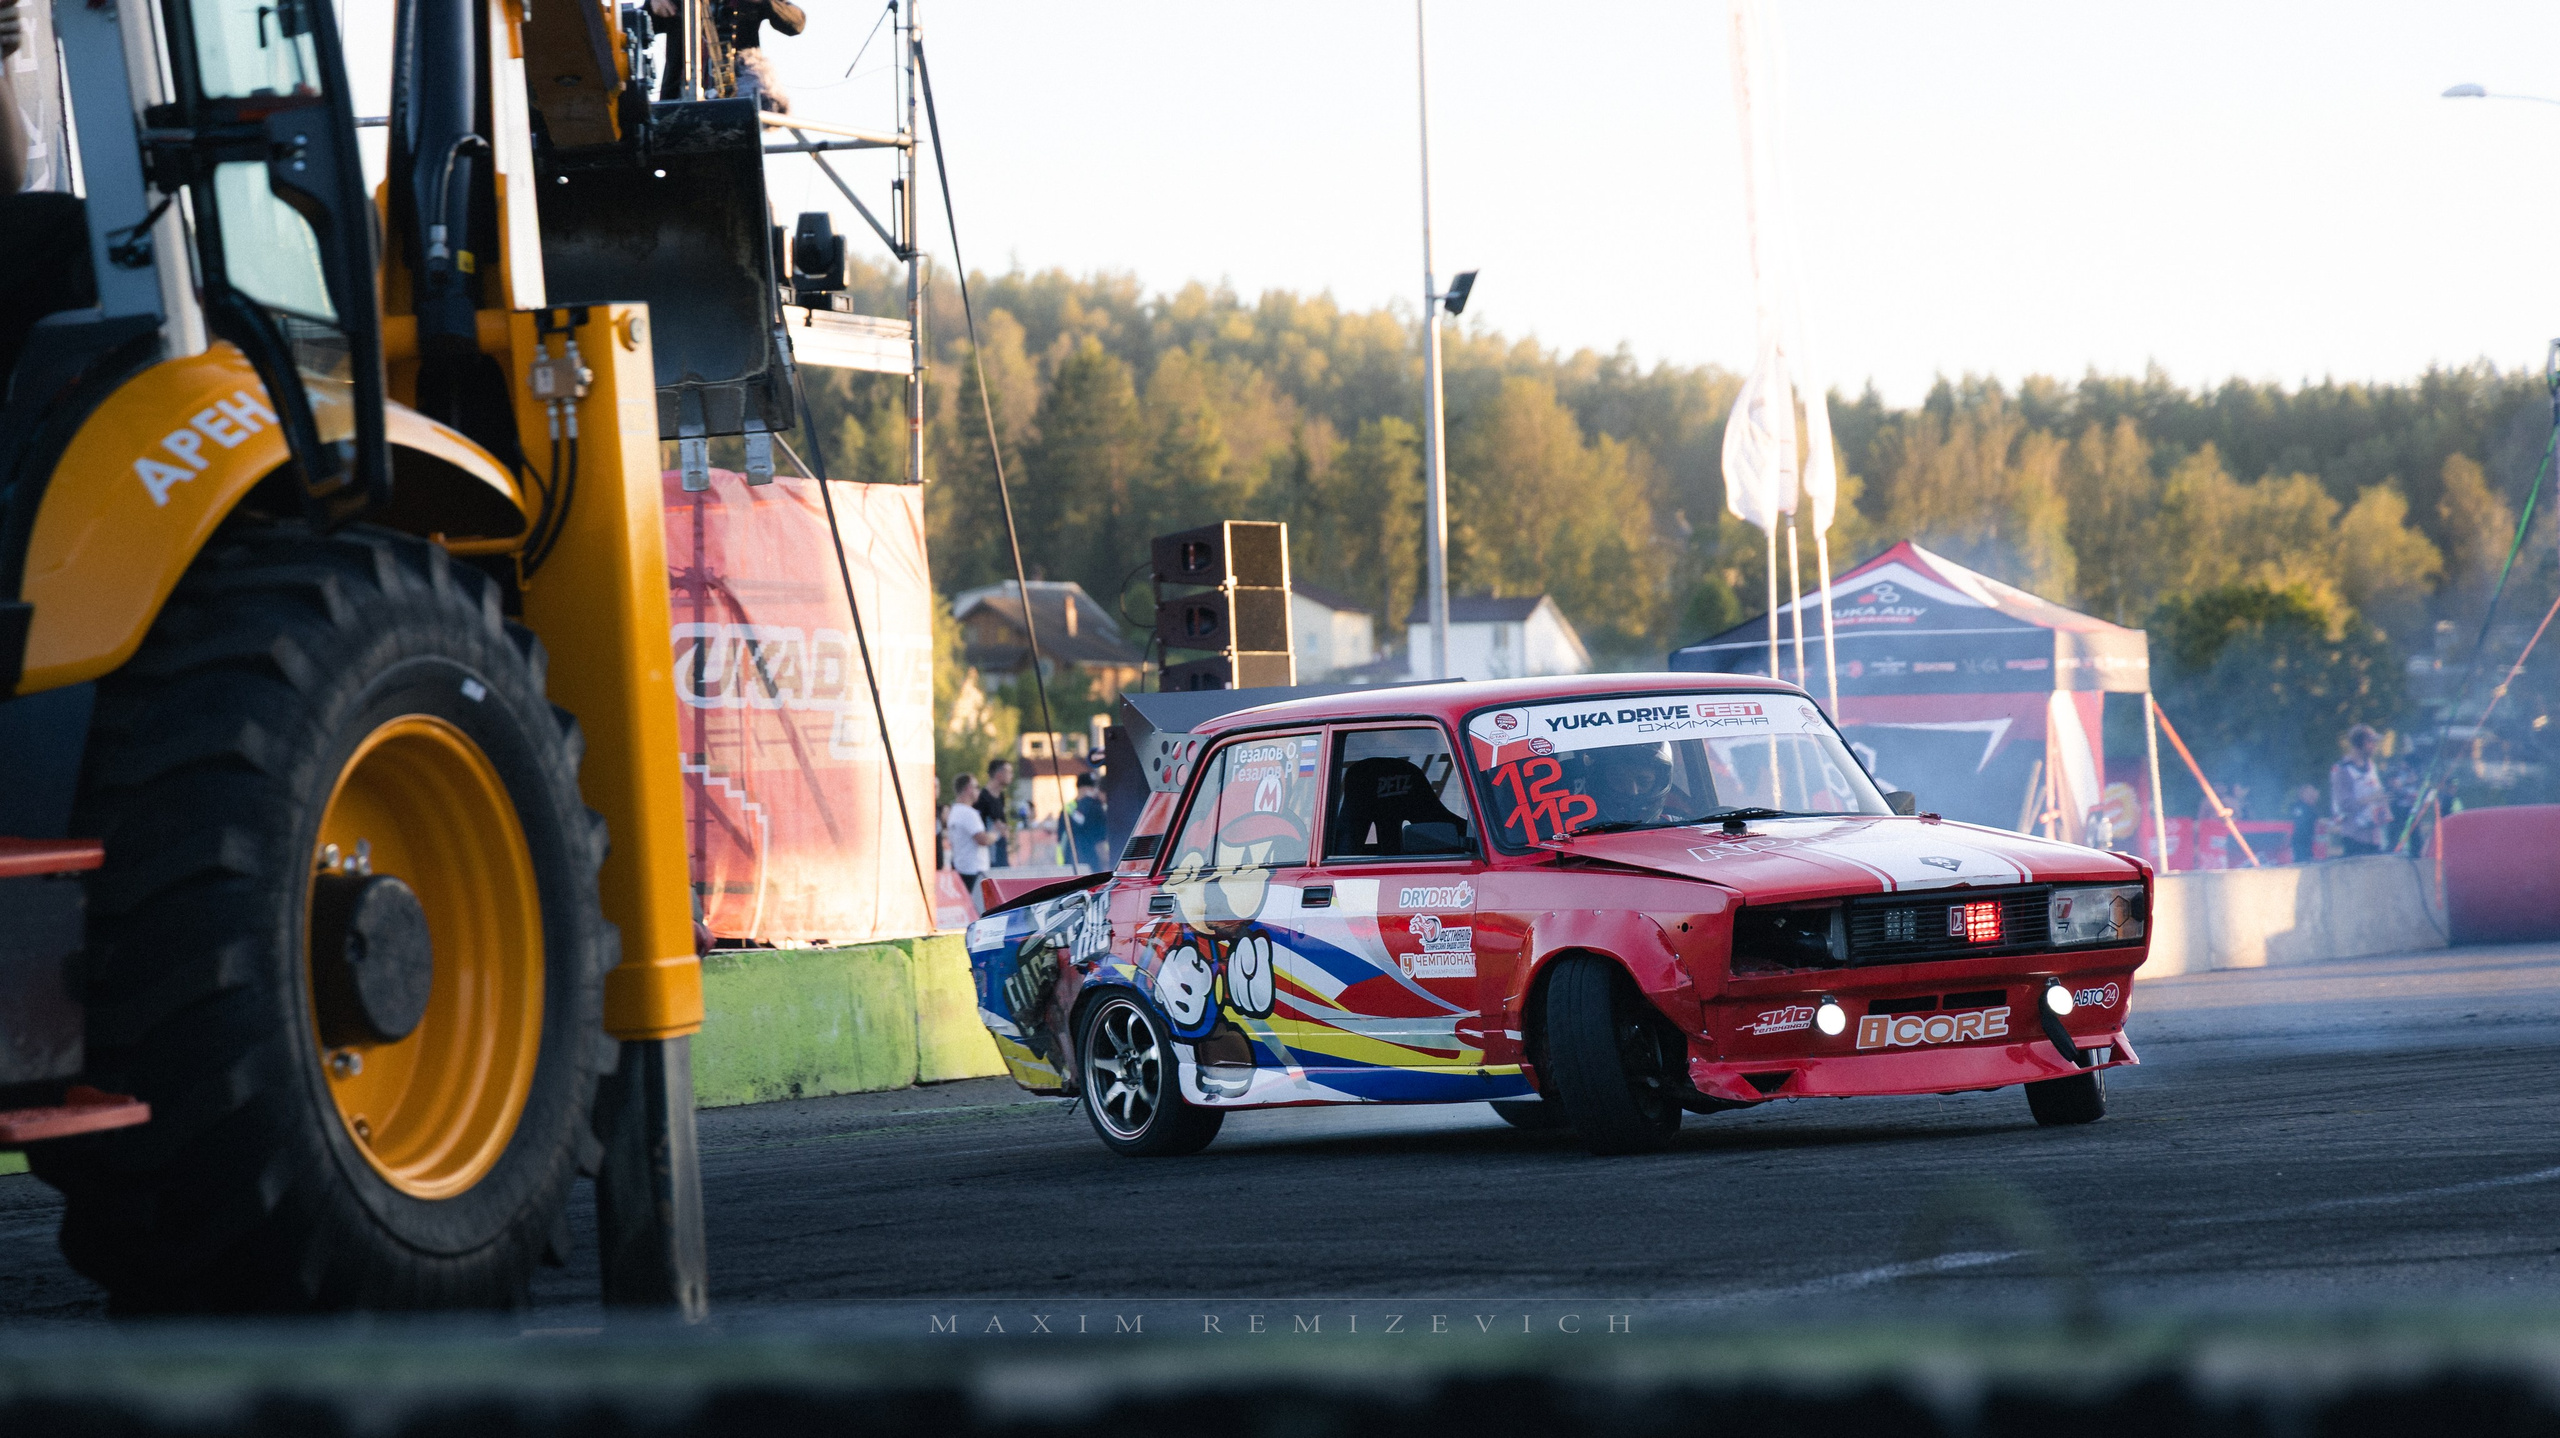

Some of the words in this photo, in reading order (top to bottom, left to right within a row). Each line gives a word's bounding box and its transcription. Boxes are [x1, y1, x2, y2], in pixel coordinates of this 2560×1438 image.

[133, 384, 281, 507] АРЕН
[1545, 711, 1613, 732] YUKA
[1617, 705, 1690, 724] DRIVE
[1699, 703, 1761, 717] FEST
[1638, 717, 1769, 733] ДЖИМХАНА
[1234, 745, 1284, 764] Гезалов
[1231, 765, 1283, 783] Гезалов
[1492, 757, 1570, 804] 12
[1505, 794, 1598, 847] 112
[1401, 889, 1458, 907] DRYDRY
[1416, 954, 1475, 967] ЧЕМПИОНАТ
